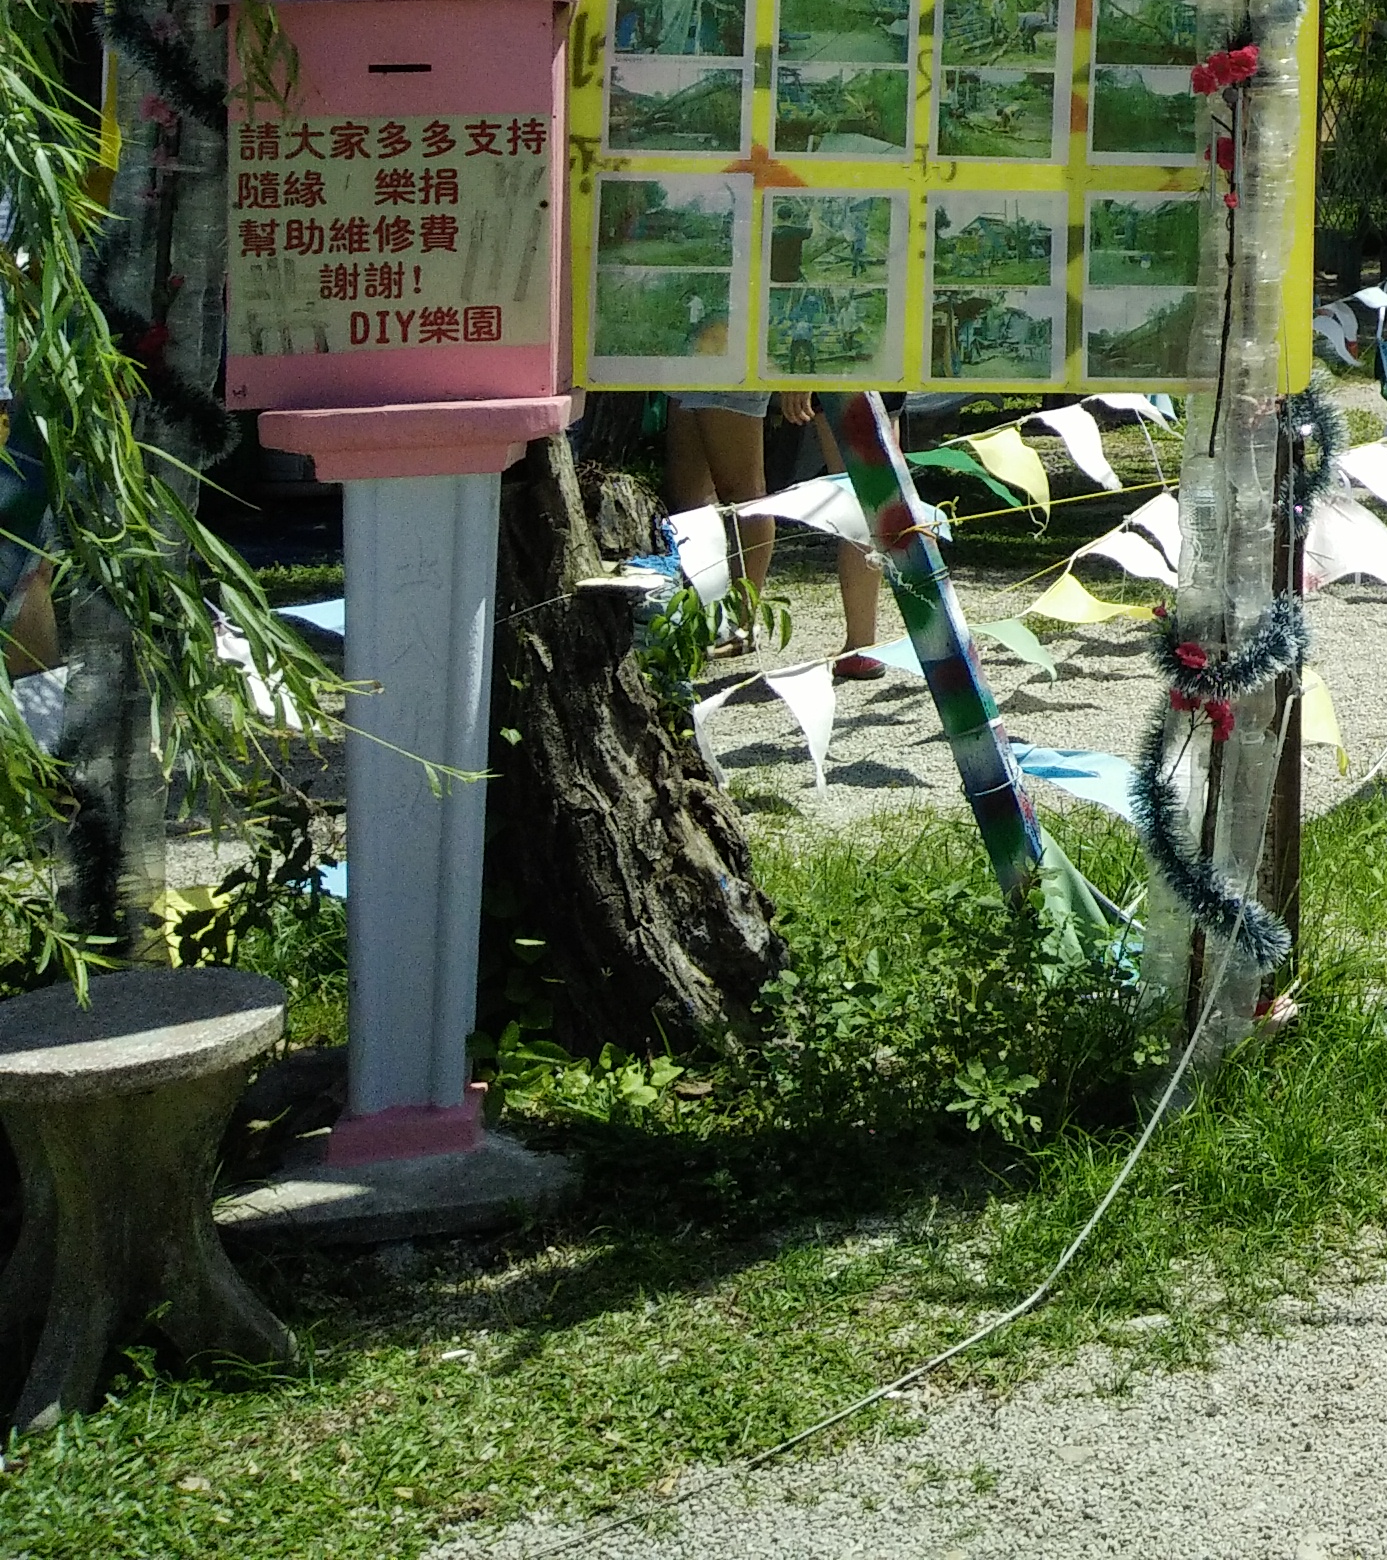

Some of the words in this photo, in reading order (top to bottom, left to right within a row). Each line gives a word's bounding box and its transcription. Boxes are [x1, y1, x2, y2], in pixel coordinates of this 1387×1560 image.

[238, 118, 548, 161] 請大家多多支持
[237, 169, 328, 210] 隨緣
[373, 167, 460, 206] 樂捐
[238, 214, 460, 257] 幫助維修費
[319, 261, 423, 301] 謝謝!
[350, 305, 503, 345] DIY樂園
